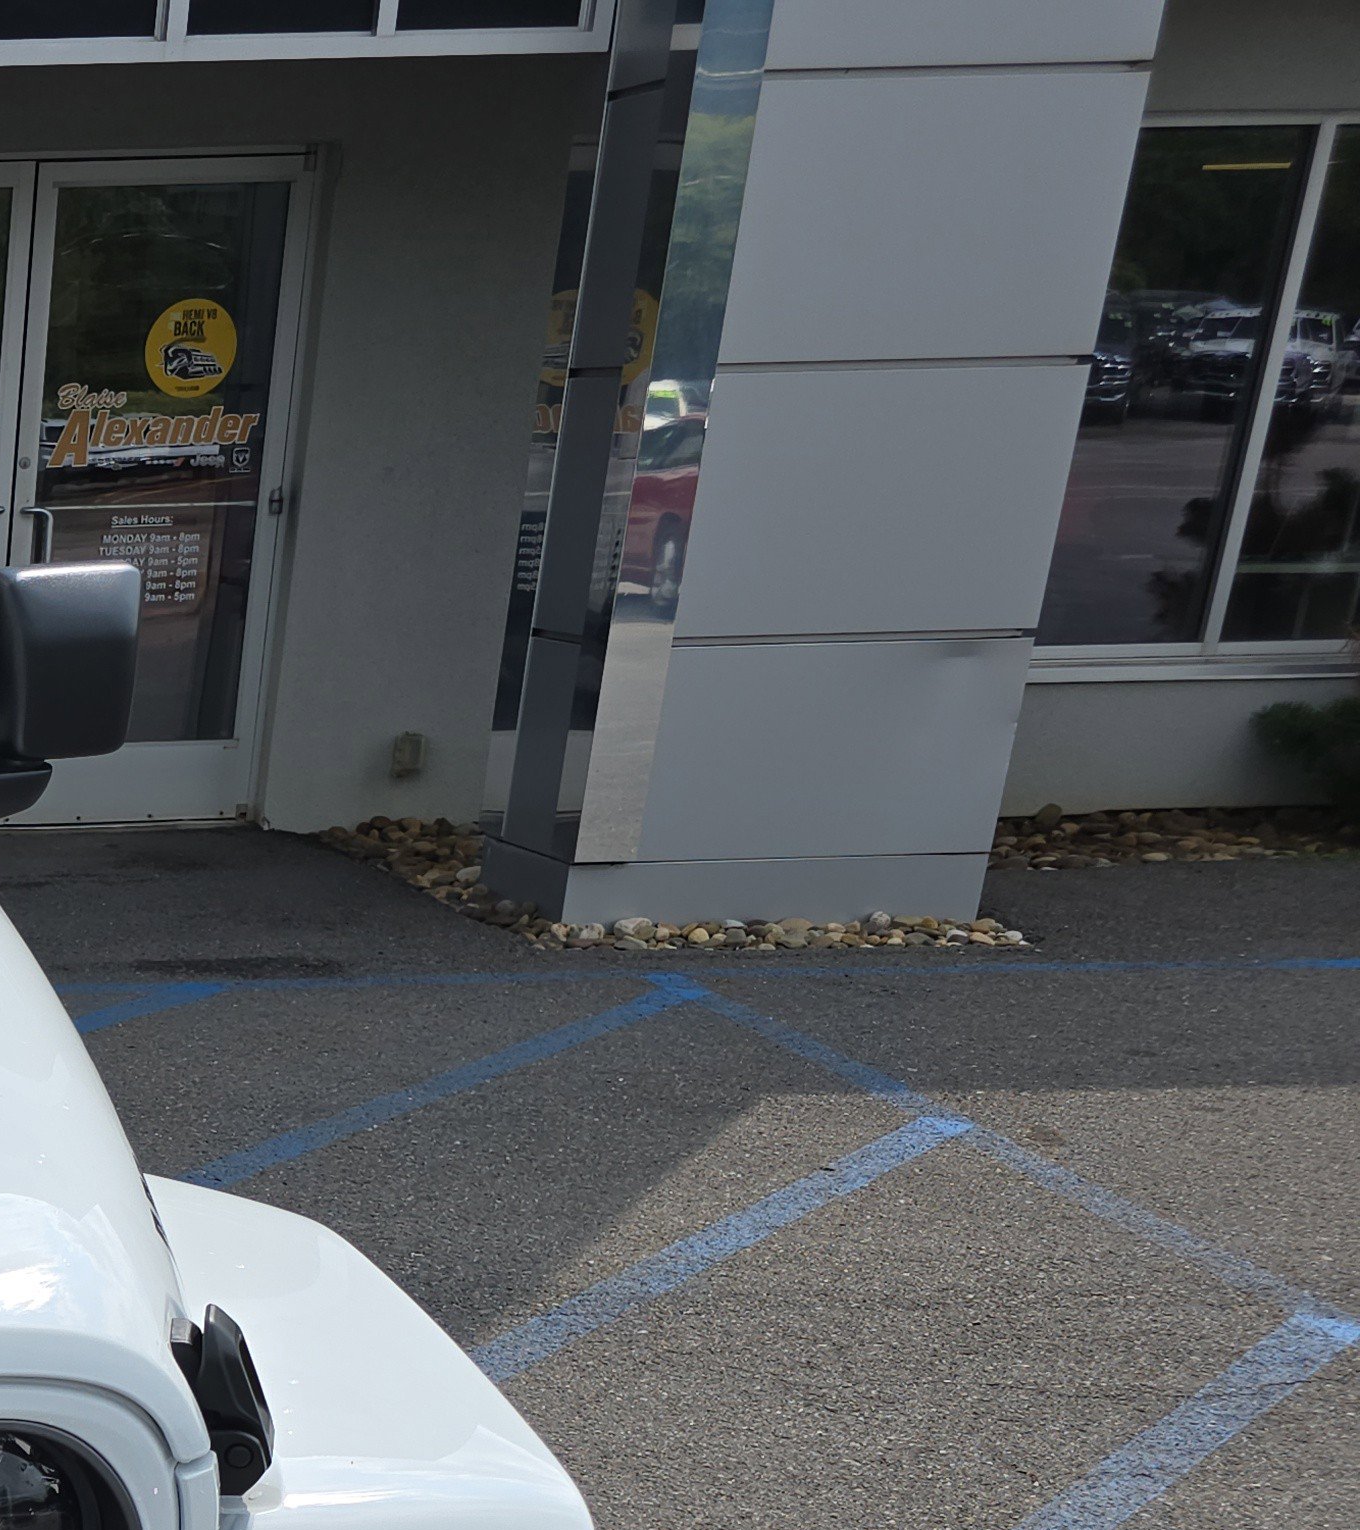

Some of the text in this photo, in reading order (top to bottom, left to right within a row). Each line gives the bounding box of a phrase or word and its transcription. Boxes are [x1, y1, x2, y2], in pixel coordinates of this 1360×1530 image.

[174, 320, 205, 337] BACK
[58, 383, 127, 410] Blaise
[46, 406, 260, 468] Alexander
[111, 515, 174, 525] Sales Hours:
[102, 534, 147, 544] MONDAY
[149, 533, 170, 542] 9am
[179, 532, 200, 542] 8pm
[99, 546, 147, 556] TUESDAY
[148, 545, 169, 554] 9am
[178, 544, 199, 554] 8pm
[147, 557, 168, 566] 9am
[177, 556, 198, 566] 5pm
[146, 569, 167, 578] 9am
[176, 568, 197, 578] 8pm
[145, 581, 166, 590] 9am
[174, 580, 196, 590] 8pm
[144, 593, 165, 602] 9am
[174, 592, 195, 602] 5pm
